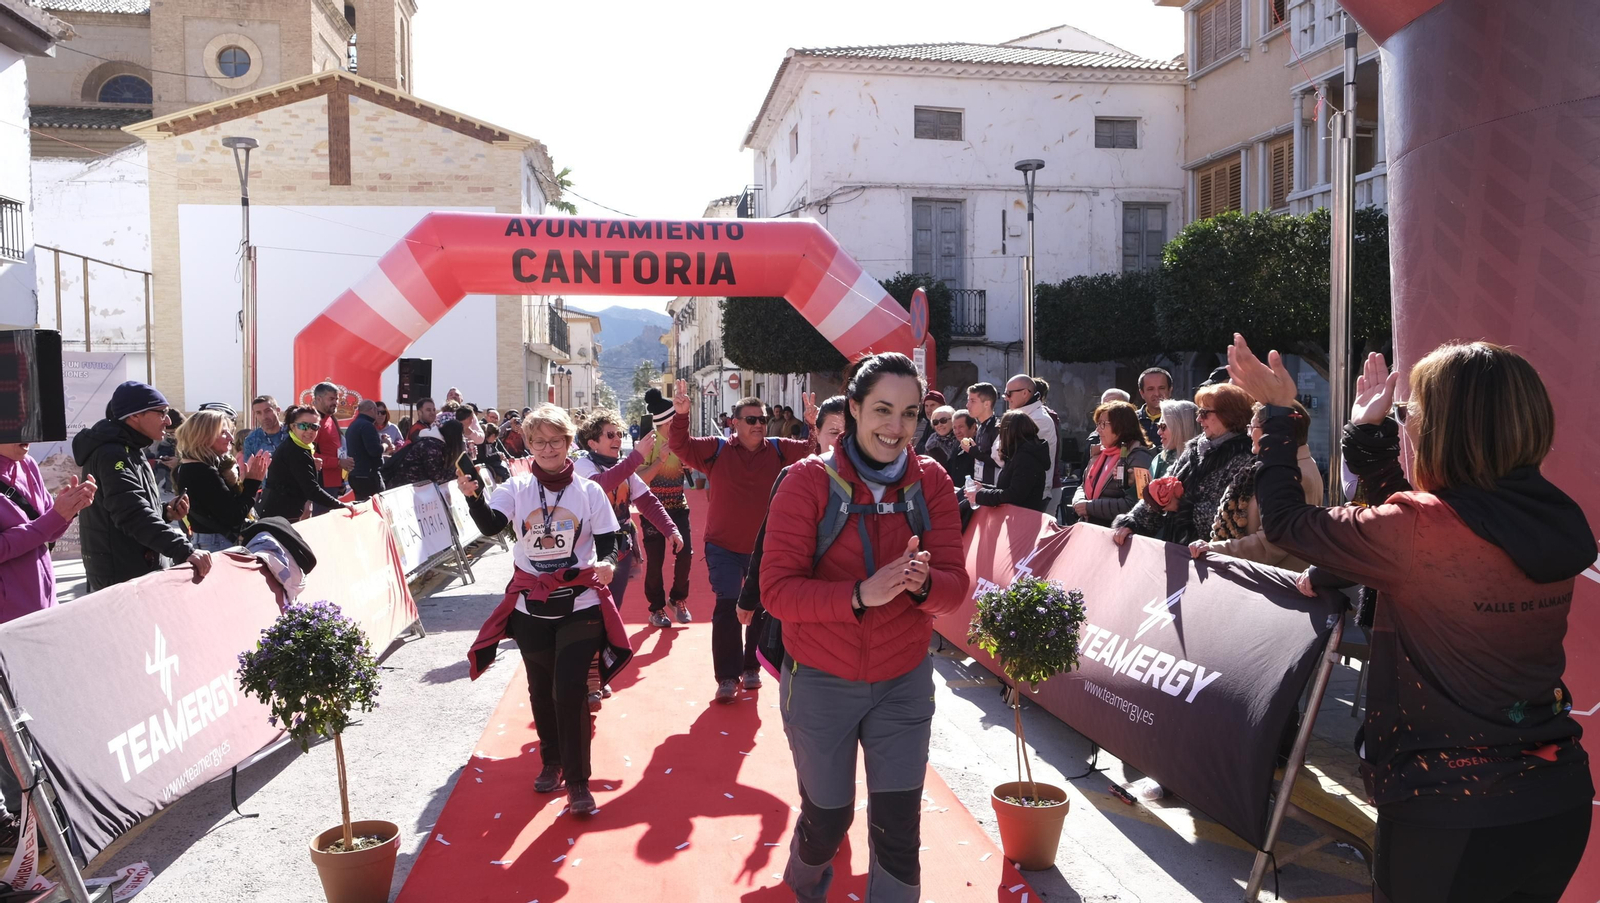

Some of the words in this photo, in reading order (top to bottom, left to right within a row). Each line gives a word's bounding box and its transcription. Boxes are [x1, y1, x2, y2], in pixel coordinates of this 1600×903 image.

[504, 218, 744, 240] AYUNTAMIENTO
[511, 247, 737, 286] CANTORIA
[63, 370, 89, 378] IONES
[400, 513, 446, 548] CATORIA
[533, 533, 565, 550] 46
[1473, 601, 1515, 613] VALLE
[1521, 600, 1534, 612] DE
[1078, 623, 1223, 704] TEAMERGY
[1084, 679, 1155, 726] www.teamergy.es
[107, 668, 238, 783] TEAMERGY
[161, 739, 231, 801] www.teamergy.es
[25, 831, 35, 851] EL
